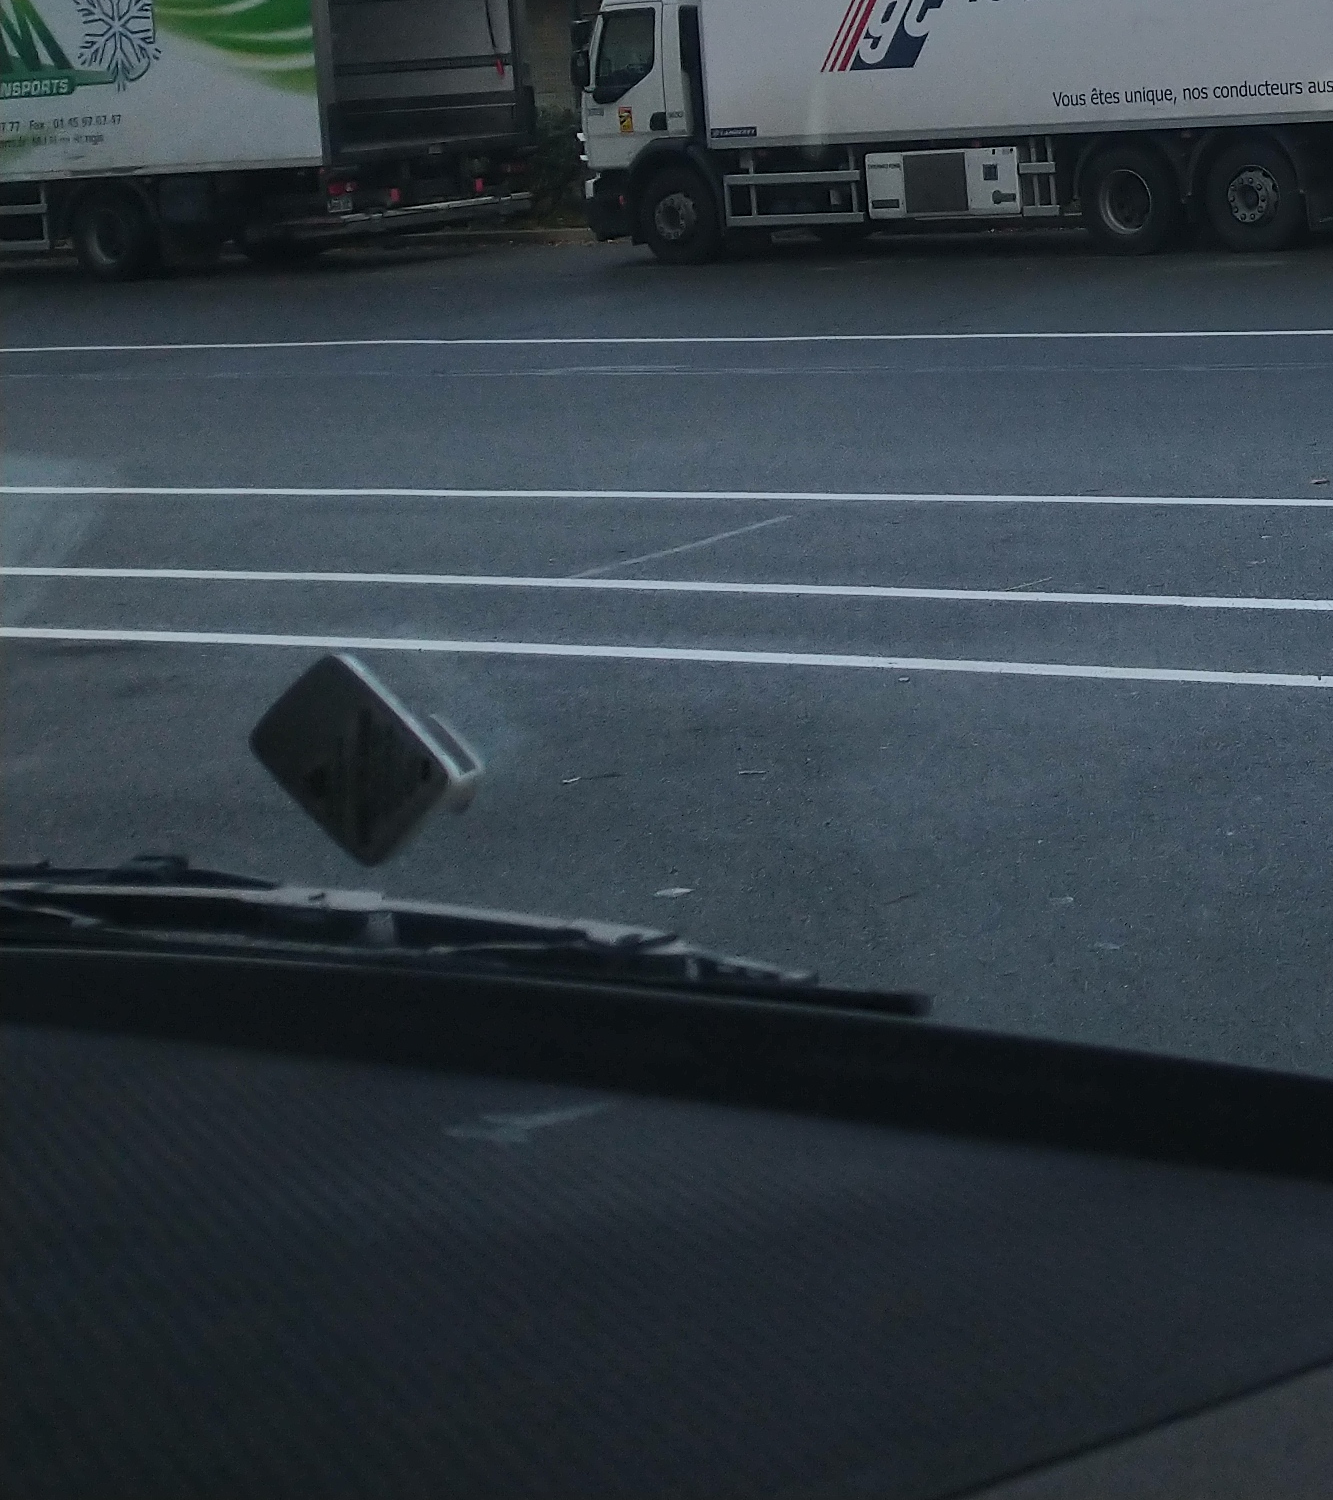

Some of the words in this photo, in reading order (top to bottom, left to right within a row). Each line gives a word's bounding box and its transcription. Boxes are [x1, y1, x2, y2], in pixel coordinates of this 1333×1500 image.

[1053, 91, 1086, 107] Vous
[1091, 87, 1120, 105] êtes
[1124, 88, 1178, 105] unique,
[1183, 88, 1208, 100] nos
[1213, 80, 1303, 98] conducteurs
